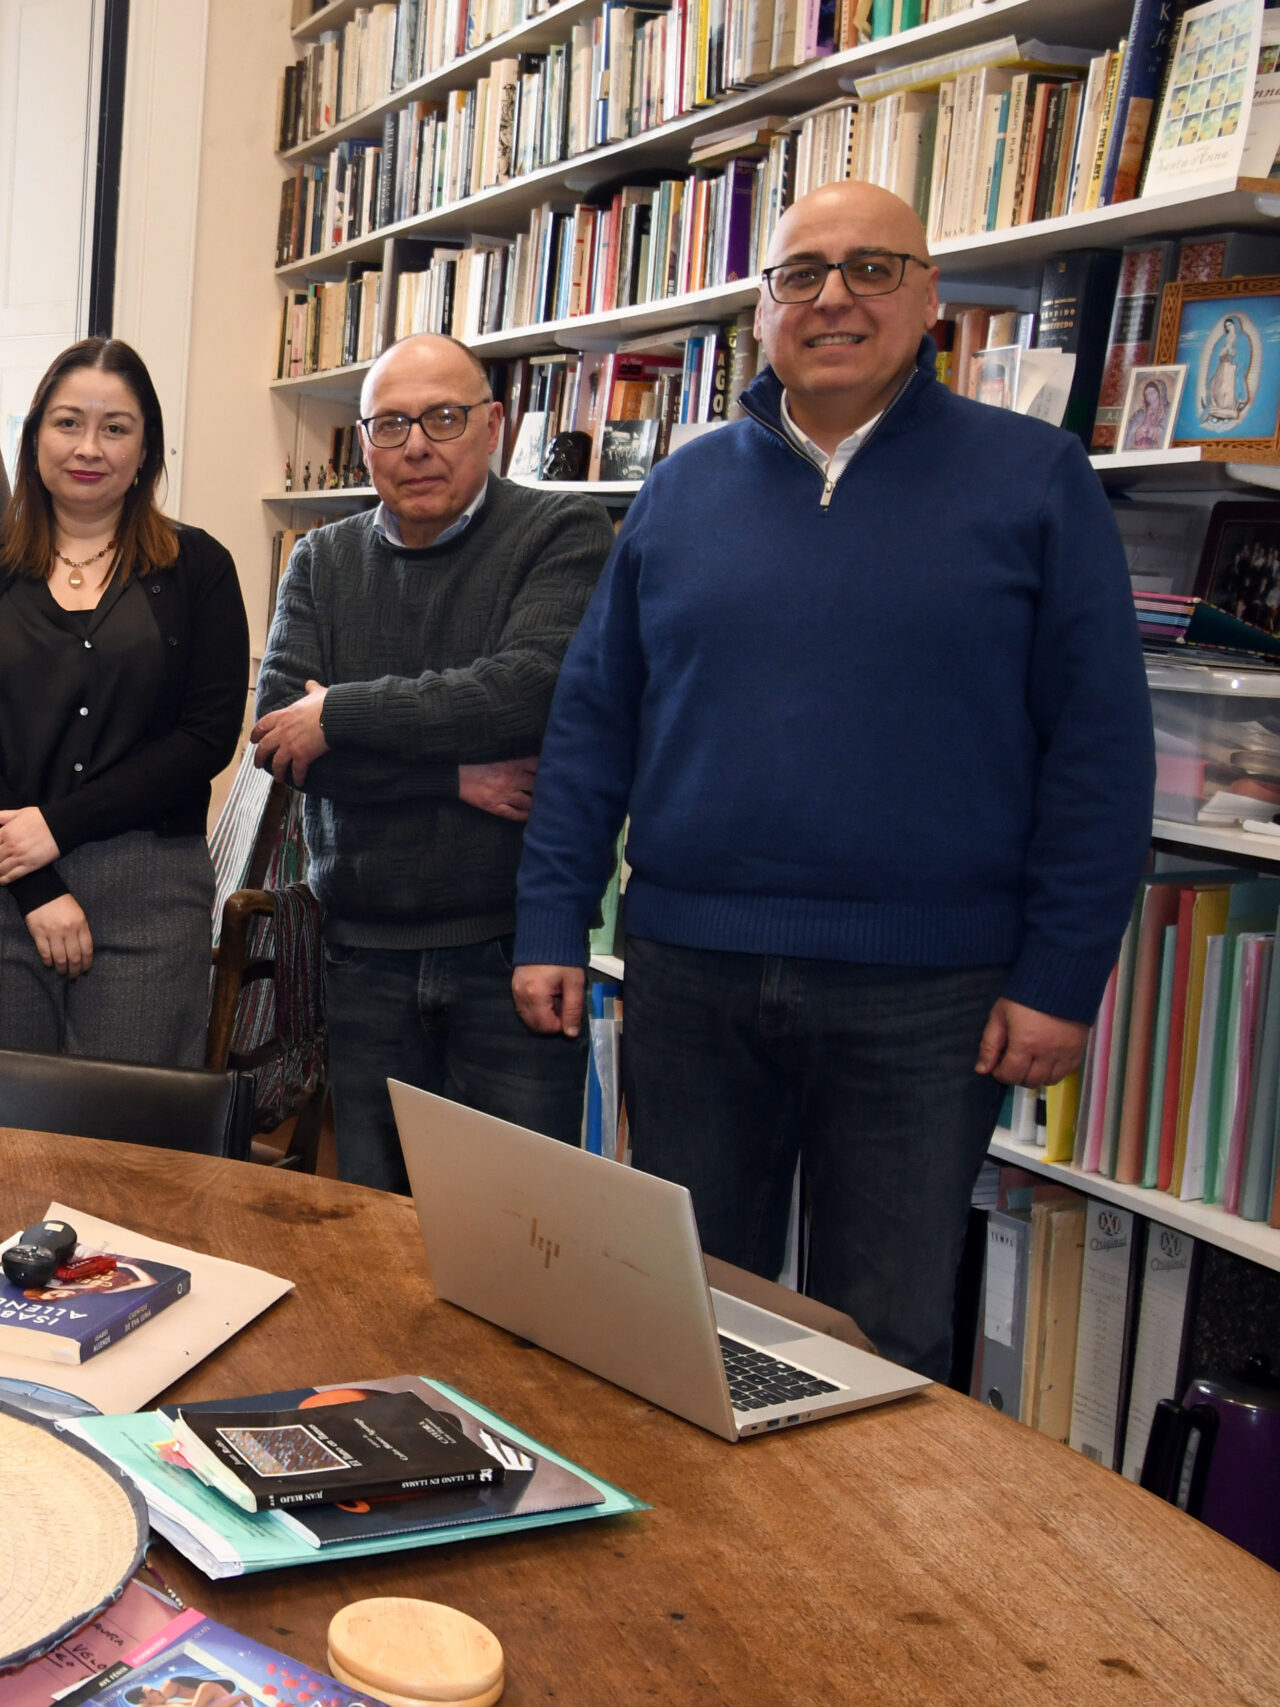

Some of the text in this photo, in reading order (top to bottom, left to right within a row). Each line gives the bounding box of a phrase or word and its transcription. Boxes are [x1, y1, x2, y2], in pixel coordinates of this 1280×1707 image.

[1093, 150, 1104, 181] PLAYS
[94, 1328, 109, 1342] ISABEL
[93, 1335, 111, 1352] ALLENDE
[348, 1459, 363, 1468] El
[401, 1473, 475, 1489] EL LLANO EN LLAMAS
[280, 1493, 304, 1504] RULFO
[305, 1490, 323, 1501] JUAN
[98, 1675, 112, 1688] AVE
